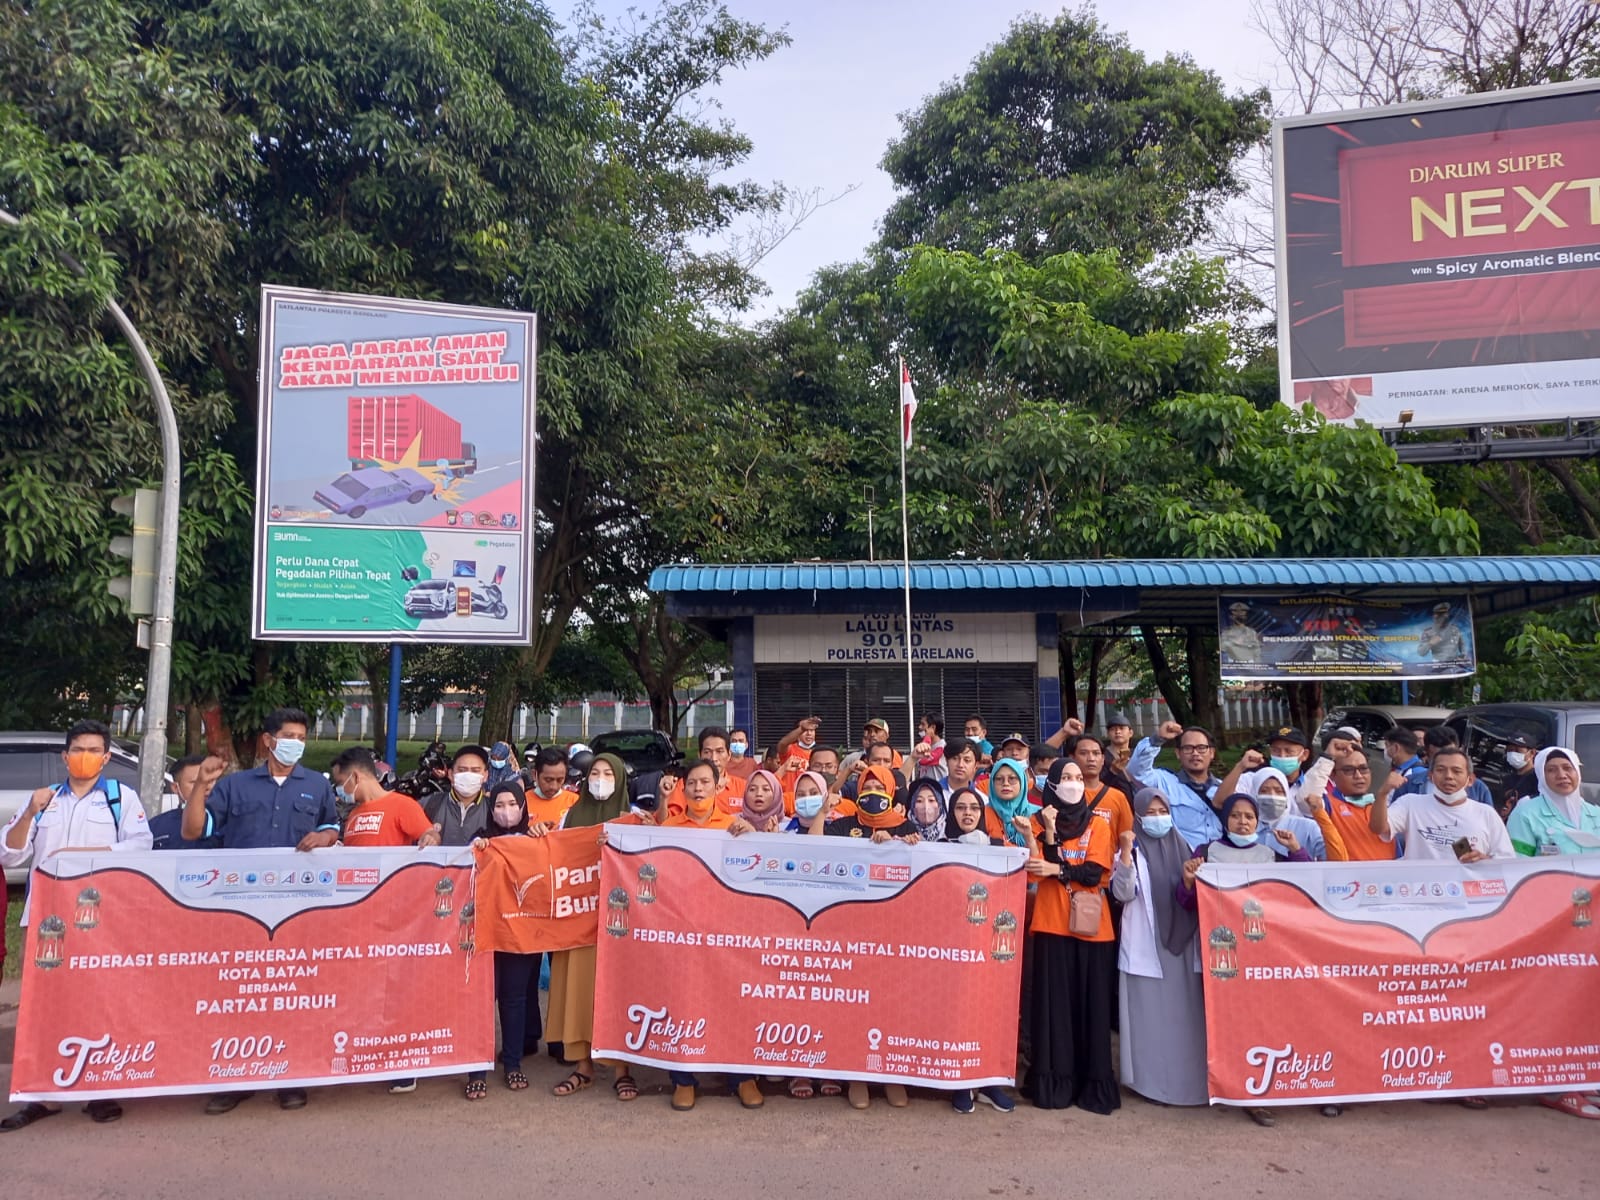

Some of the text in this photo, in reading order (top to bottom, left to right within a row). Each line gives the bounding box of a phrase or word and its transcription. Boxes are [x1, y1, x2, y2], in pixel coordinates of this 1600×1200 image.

[1410, 152, 1564, 183] DJARUM SUPER
[1412, 266, 1432, 276] With
[1436, 261, 1477, 277] Spicy
[1482, 254, 1554, 270] Aromatic
[281, 331, 506, 362] JAGA JARAK AMAN
[282, 350, 503, 374] KENDARAAN SAAT
[281, 364, 519, 387] AKAN MENDAHULUI
[1451, 386, 1490, 395] KARENA
[1546, 381, 1570, 389] SAYA
[276, 556, 359, 570] Perlu Dana Cepat
[276, 569, 391, 582] Pegadaian Pilihan Tepat
[846, 621, 888, 632] LALU
[1303, 620, 1340, 632] STOP
[862, 634, 922, 646] 9010
[1262, 635, 1334, 643] PENGGUNAAN
[828, 648, 896, 660] POLRESTA
[725, 857, 751, 866] FSPMI
[179, 873, 208, 882] FSPMI
[1326, 886, 1351, 894] FSPMI
[556, 895, 600, 918] Bur
[633, 928, 986, 962] FEDERASI SERIKAT PEKERJA METAL INDONESIA
[70, 943, 452, 970] FEDERASI SERIKAT PEKERJA METAL INDONESIA
[761, 954, 852, 970] KOTA BATAM
[218, 966, 318, 981] KOTA BATAM
[1245, 954, 1598, 980] FEDERASI SERIKAT PEKERJA METAL INDONESIA
[780, 972, 832, 983] BERSAMA
[1378, 978, 1468, 992] KOTA BATAM
[239, 982, 296, 994] BERSAMA
[741, 984, 870, 1004] PARTAI BURUH
[196, 994, 336, 1015] PARTAI BURUH
[1397, 994, 1448, 1005] BERSAMA
[1363, 1005, 1486, 1026] PARTAI BURUH
[626, 1004, 706, 1050] Takjil
[754, 1022, 824, 1045] 1000+
[353, 1028, 453, 1048] SIMPANG PANBIL
[888, 1036, 980, 1052] SIMPANG PANBIL
[210, 1035, 286, 1060] 1000+
[351, 1044, 454, 1064] JUMAT, 22 APRIL 2022
[662, 1042, 678, 1054] The
[680, 1045, 706, 1056] Road
[1510, 1044, 1600, 1058] SIMPANG PANBI
[53, 1032, 156, 1088] Takjil
[351, 1063, 376, 1073] 17.00
[412, 1057, 430, 1066] WIB
[754, 1048, 827, 1068] Paket Takjil
[886, 1053, 918, 1064] JUMAT,
[921, 1056, 932, 1065] 22
[934, 1058, 960, 1068] APRIL
[1380, 1046, 1446, 1070] 1000+
[85, 1068, 155, 1082] On The Road
[208, 1060, 289, 1080] Paket Takjil
[886, 1064, 908, 1073] 17.00
[944, 1069, 960, 1078] WIB
[1245, 1044, 1333, 1096] Takjil
[1512, 1064, 1544, 1075] JUMAT,
[1559, 1062, 1584, 1072] APRIL
[1275, 1077, 1335, 1090] On The Road
[1382, 1071, 1452, 1089] Paket Takjil
[1513, 1074, 1536, 1084] 17.00
[1569, 1072, 1586, 1082] WIB
